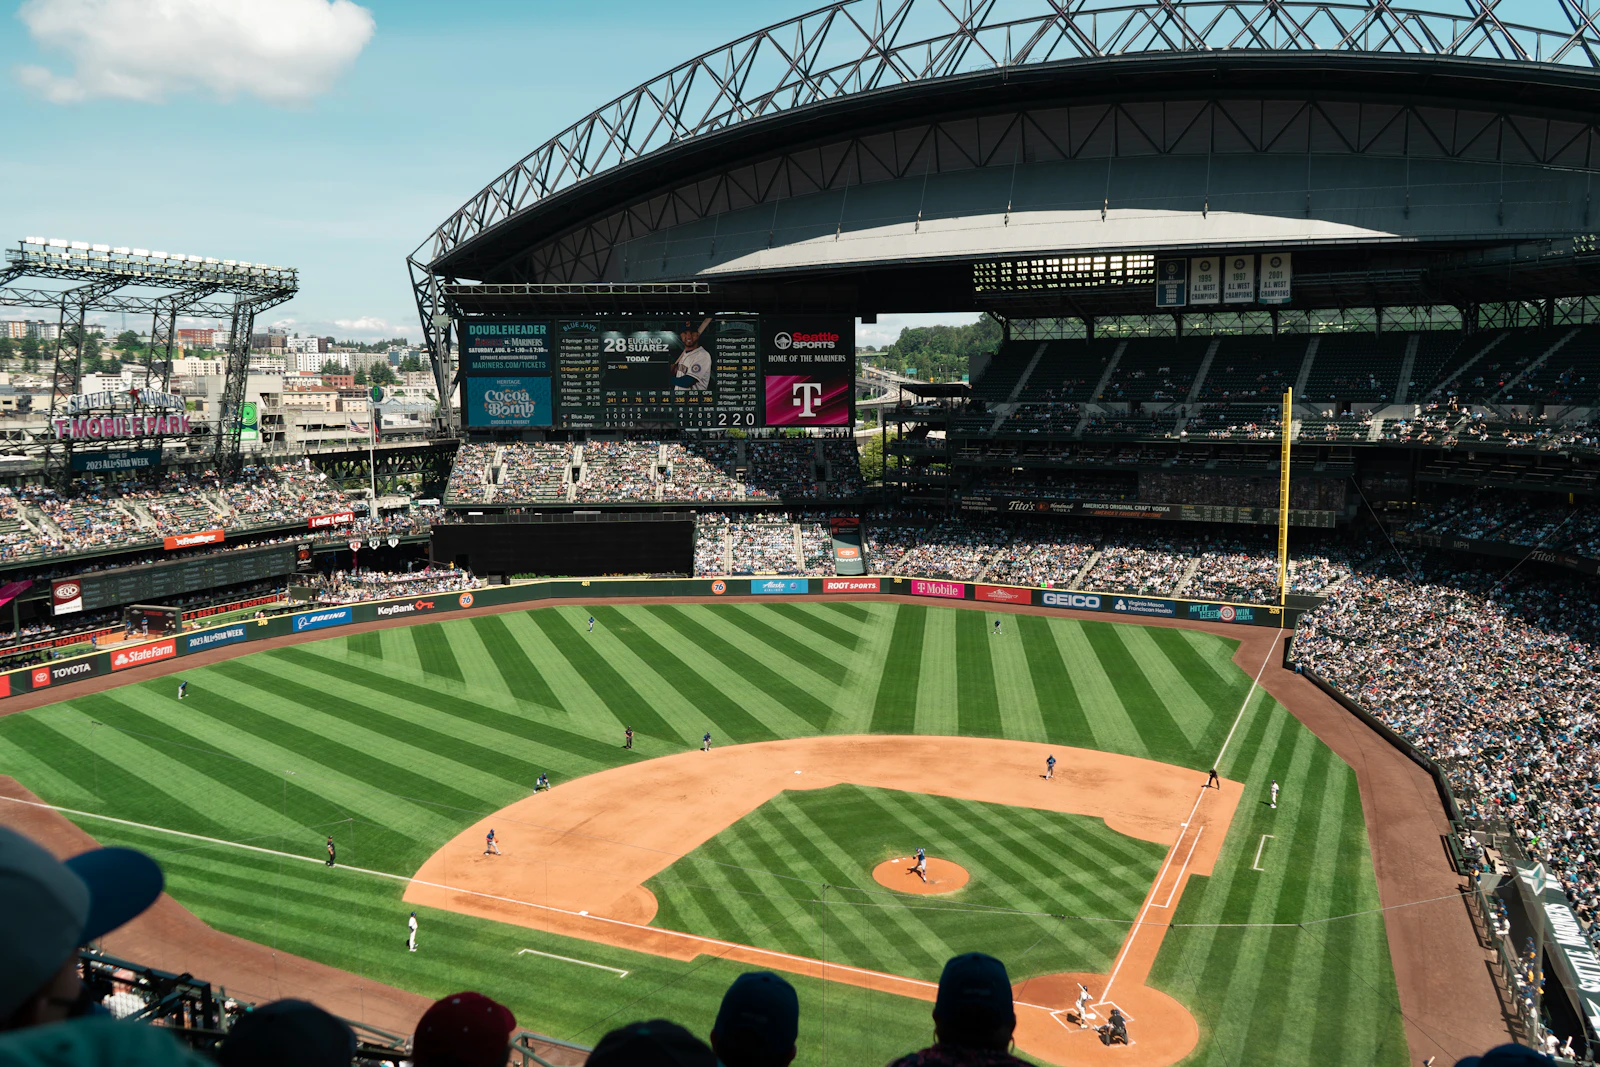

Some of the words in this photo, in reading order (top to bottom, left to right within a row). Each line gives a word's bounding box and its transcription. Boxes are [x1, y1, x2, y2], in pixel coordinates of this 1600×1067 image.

[1269, 271, 1282, 279] 2001
[469, 325, 546, 335] DOUBLEHEADER
[563, 322, 579, 332] BLUE
[580, 322, 596, 332] JAYS
[512, 338, 543, 346] MARINERS
[792, 332, 839, 342] Seattle
[604, 338, 627, 352] 28
[69, 391, 114, 413] SEATTLE
[141, 389, 185, 410] MARINERS
[484, 390, 530, 403] Cocoa
[793, 383, 821, 417] T
[488, 402, 534, 418] Bomb
[718, 413, 727, 425] 2
[733, 413, 741, 425] 2
[746, 413, 754, 425] 0
[52, 417, 143, 439] T-MOBILE
[145, 415, 192, 435] PARK
[86, 461, 102, 470] 2023
[131, 458, 149, 466] WEEK
[1008, 500, 1035, 511] Tito's
[1454, 541, 1469, 549] MPH
[1531, 550, 1556, 563] Tito's
[927, 583, 958, 596] Mobile
[462, 596, 471, 604] 76
[1044, 593, 1100, 608] GEICO
[198, 608, 217, 618] BEST
[228, 603, 241, 611] THE
[378, 604, 415, 616] KeyBank
[310, 611, 346, 623] BOEING
[55, 629, 112, 647] NORTHWEST
[189, 637, 203, 647] 2023
[227, 628, 244, 638] WEEK
[52, 663, 91, 679] TOYOTA
[1541, 902, 1590, 949] MARINERS
